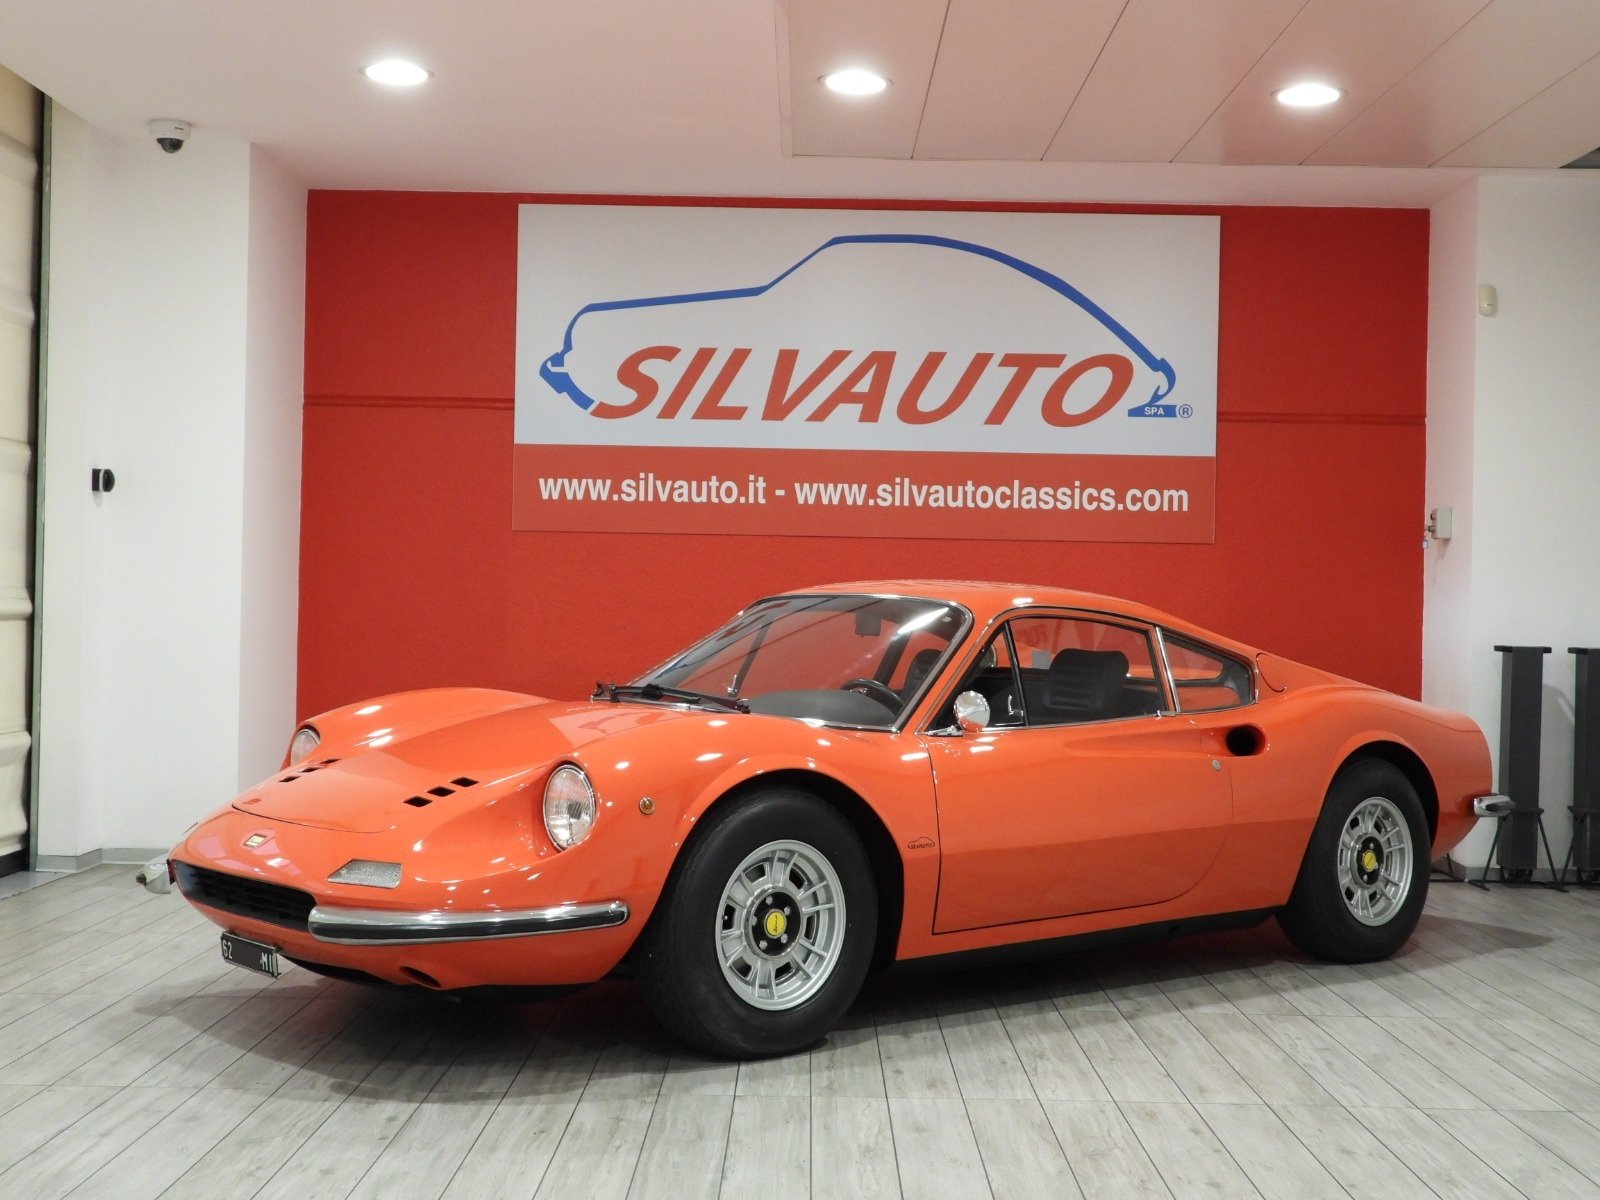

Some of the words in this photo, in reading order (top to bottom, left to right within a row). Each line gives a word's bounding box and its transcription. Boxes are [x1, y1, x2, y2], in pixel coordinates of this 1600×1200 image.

[592, 345, 1134, 428] SILVAUTO
[1144, 406, 1165, 415] SPA
[538, 472, 767, 505] www.silvauto.it
[794, 477, 1190, 513] www.silvautoclassics.com
